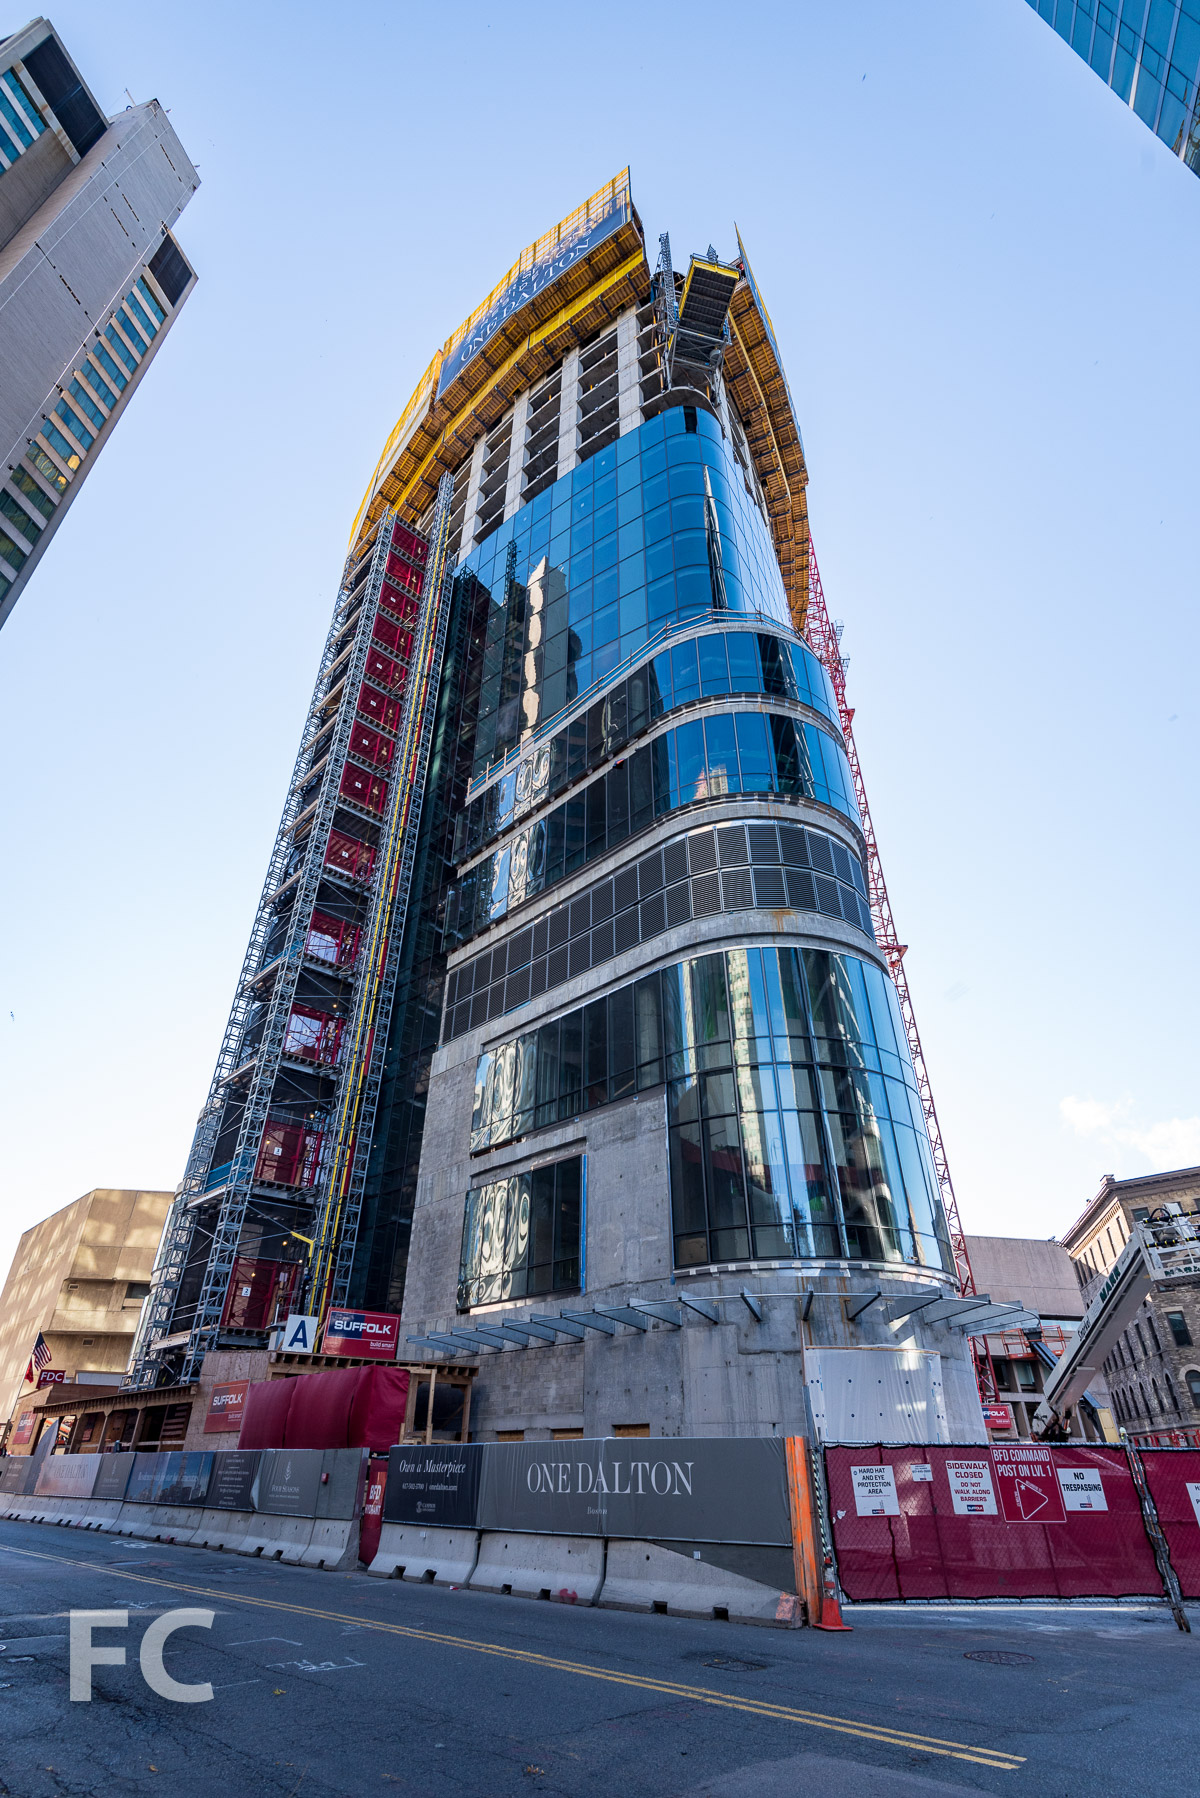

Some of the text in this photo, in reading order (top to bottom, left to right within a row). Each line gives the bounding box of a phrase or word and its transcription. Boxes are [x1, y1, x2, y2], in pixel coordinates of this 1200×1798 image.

[460, 236, 591, 362] ONE DALTON
[288, 1320, 308, 1348] A
[334, 1320, 391, 1335] SUFFOLK
[40, 1371, 64, 1382] FDC
[212, 1392, 243, 1406] SUFFOLK
[992, 1449, 1050, 1462] BFD COMMAND
[400, 1459, 467, 1478] Own a Masterpiece
[947, 1462, 988, 1470] SIDEWALK
[997, 1464, 1052, 1477] POST ON LVL 1
[527, 1461, 695, 1496] ONE DALTON
[955, 1471, 984, 1479] CLOSED
[1073, 1472, 1085, 1480] NO
[369, 1485, 382, 1500] BFD
[1061, 1483, 1102, 1492] TRESPASSING
